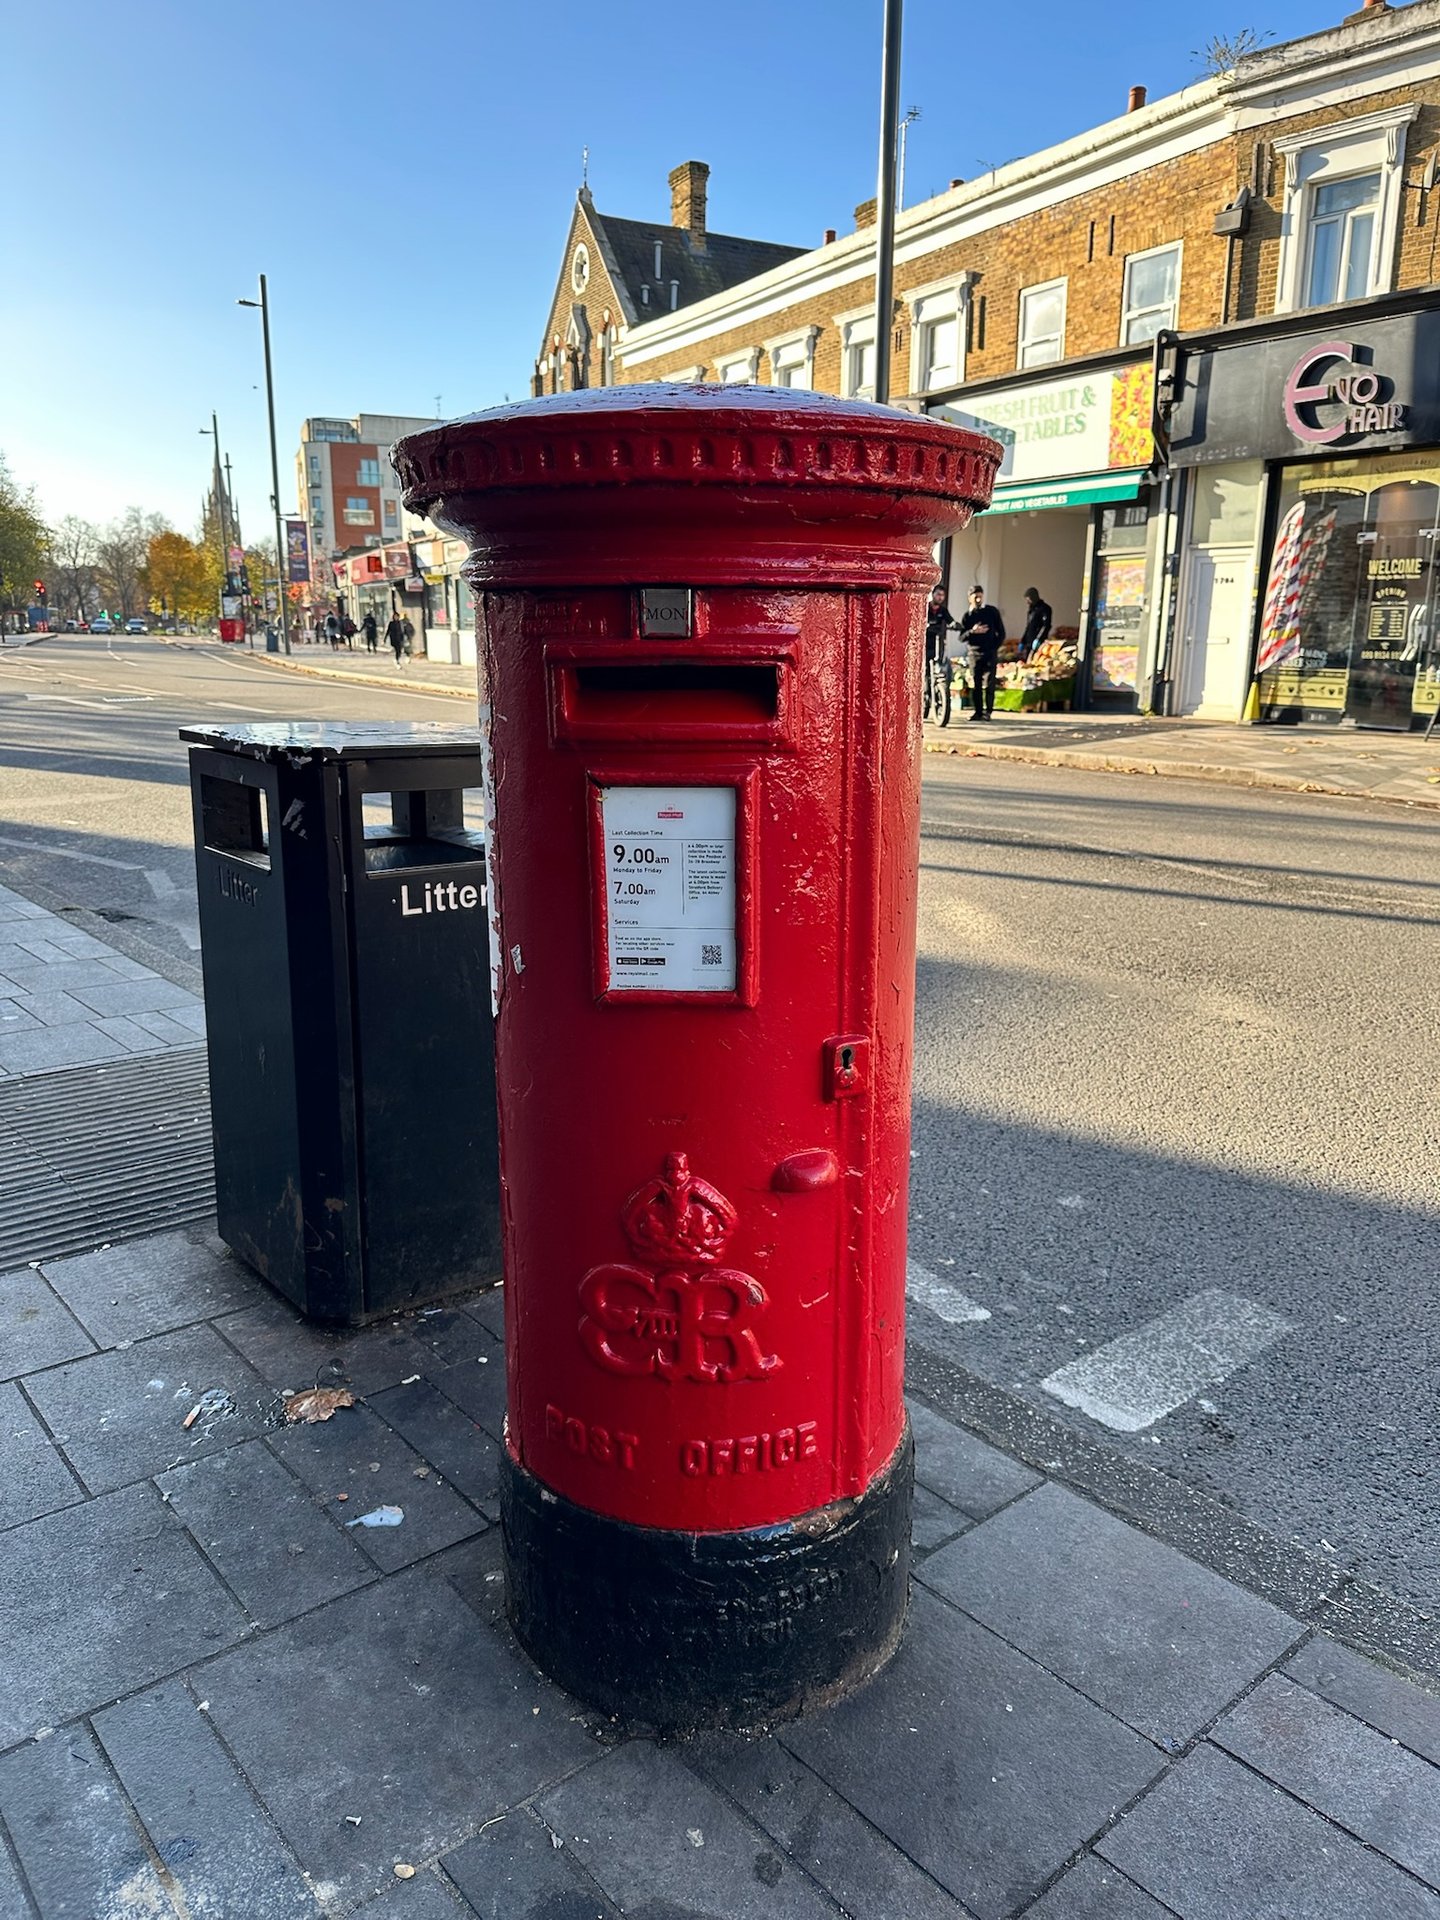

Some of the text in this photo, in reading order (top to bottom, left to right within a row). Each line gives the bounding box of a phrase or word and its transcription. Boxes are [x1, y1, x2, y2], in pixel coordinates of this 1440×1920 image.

[975, 385, 1097, 428] FRESH FRUIT &
[1349, 403, 1404, 434] HAIR
[1368, 558, 1423, 575] WELCOME
[646, 607, 686, 621] MON
[613, 844, 670, 864] 9.00am
[218, 865, 258, 907] Litter
[401, 881, 487, 916] Litter
[613, 881, 656, 895] 7.00am
[545, 1403, 817, 1476] POST OFFICE
